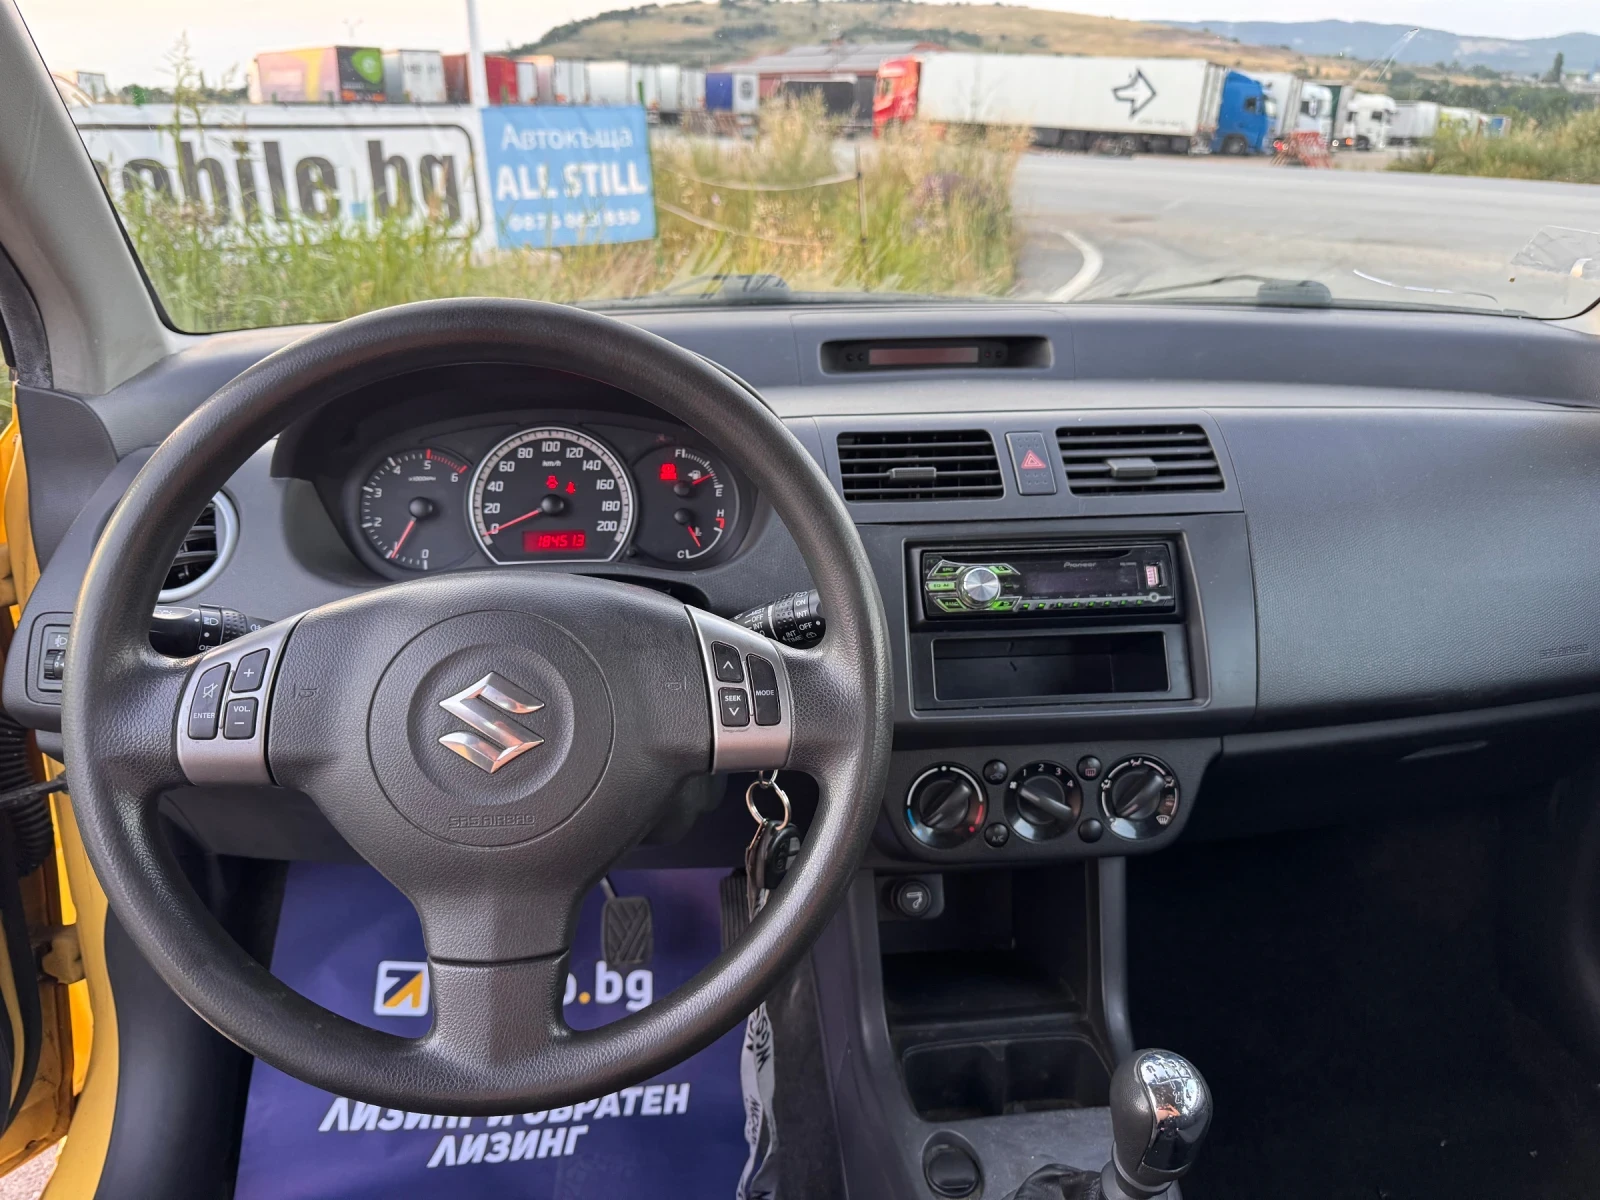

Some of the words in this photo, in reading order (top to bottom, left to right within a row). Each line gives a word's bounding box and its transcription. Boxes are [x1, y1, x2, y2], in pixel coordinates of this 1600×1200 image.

[502, 123, 633, 152] Автокъща
[93, 140, 462, 224] obile.bg
[496, 164, 559, 201] ALL
[563, 161, 648, 197] STILL
[541, 441, 560, 452] 100
[517, 448, 533, 458] 80
[566, 448, 583, 458] 120
[675, 449, 682, 457] F
[393, 466, 401, 475] 4
[424, 461, 431, 470] 5
[499, 461, 515, 472] 60
[582, 460, 601, 471] 140
[451, 473, 459, 482] 6
[487, 481, 503, 492] 40
[596, 479, 614, 490] 160
[374, 488, 382, 498] 3
[715, 489, 723, 497] E
[484, 503, 500, 513] 20
[602, 501, 620, 512] 180
[717, 509, 724, 517] H
[374, 517, 382, 527] 2
[596, 521, 617, 531] 200
[538, 535, 585, 547] 184513
[422, 549, 429, 558] 0
[677, 550, 684, 559] C
[752, 614, 764, 622] OFF
[797, 610, 808, 618] INT
[753, 622, 763, 630] INT
[799, 622, 812, 630] OFF
[233, 705, 251, 713] VOL.
[1038, 764, 1044, 772] 2
[1055, 768, 1062, 776] 3
[481, 814, 535, 826] AIRBAG
[426, 1125, 589, 1168] ЛИЗИНГ
